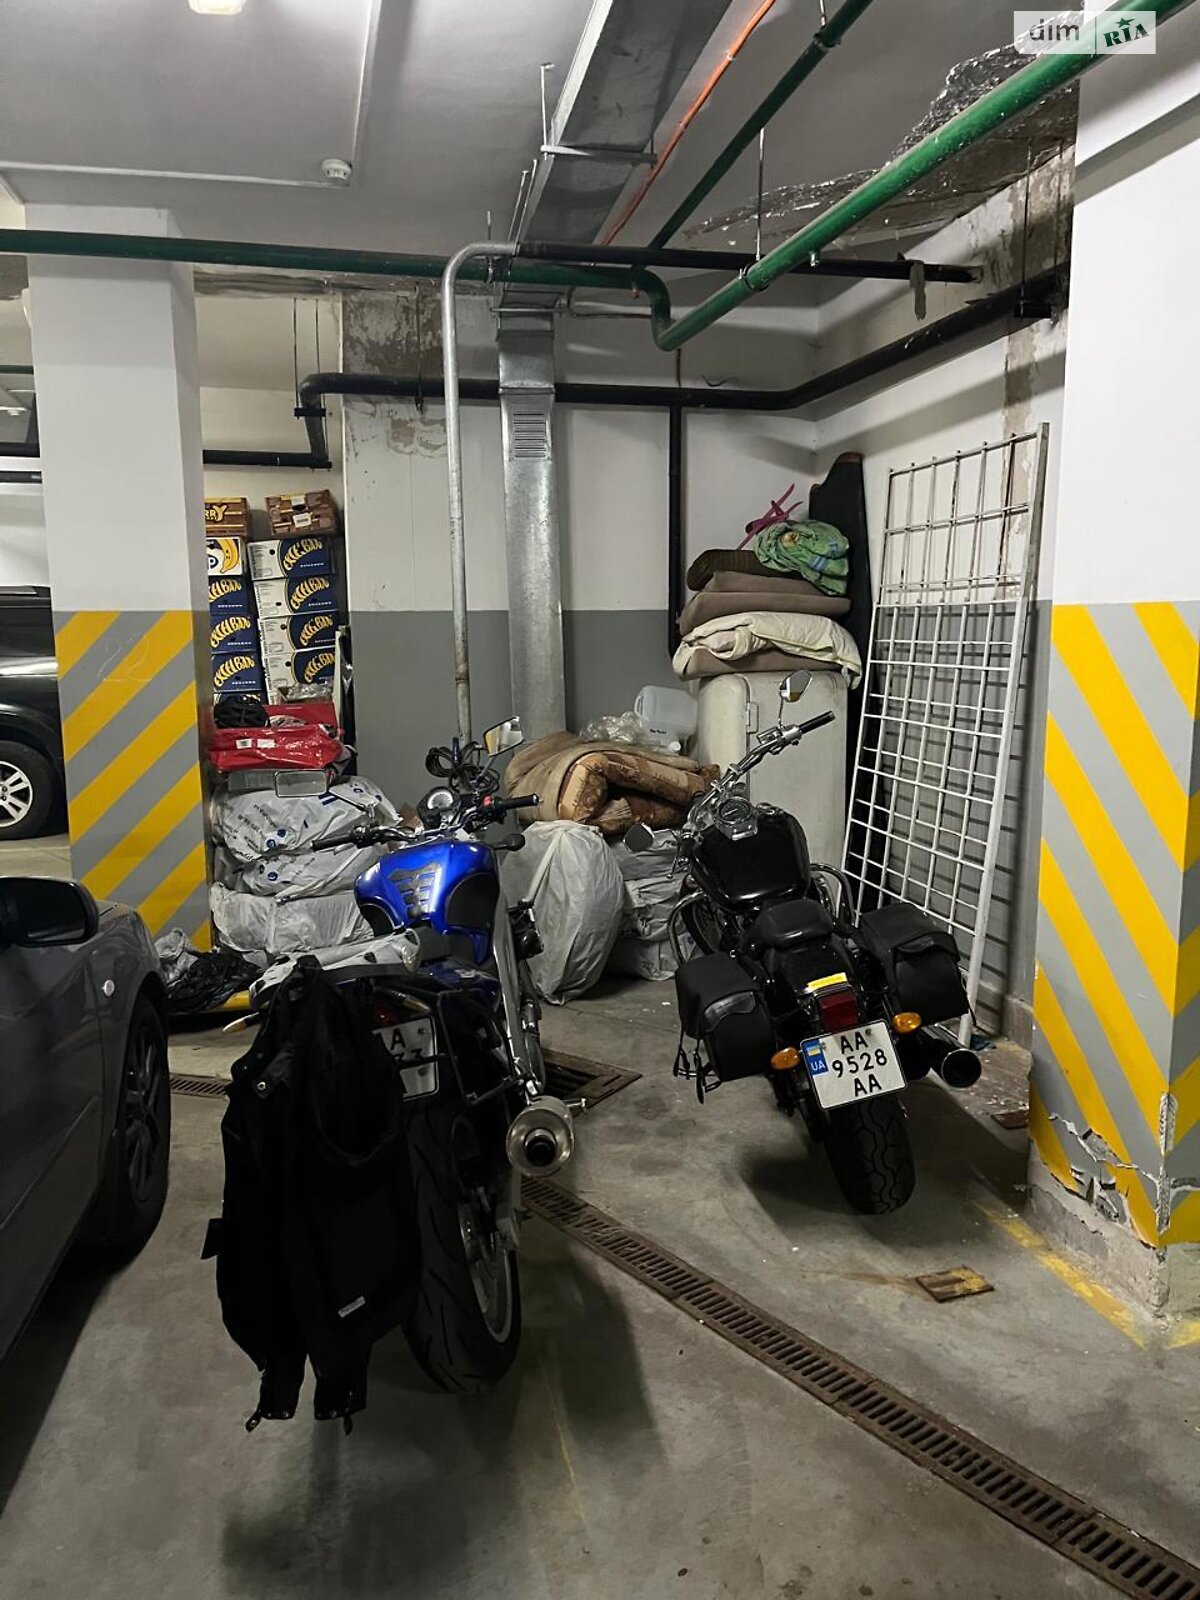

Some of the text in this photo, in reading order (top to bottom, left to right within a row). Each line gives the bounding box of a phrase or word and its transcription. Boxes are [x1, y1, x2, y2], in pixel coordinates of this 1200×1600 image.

[840, 1031, 869, 1054] AA
[810, 1060, 826, 1071] UA
[831, 1048, 888, 1078] 9528
[853, 1073, 883, 1097] AA
